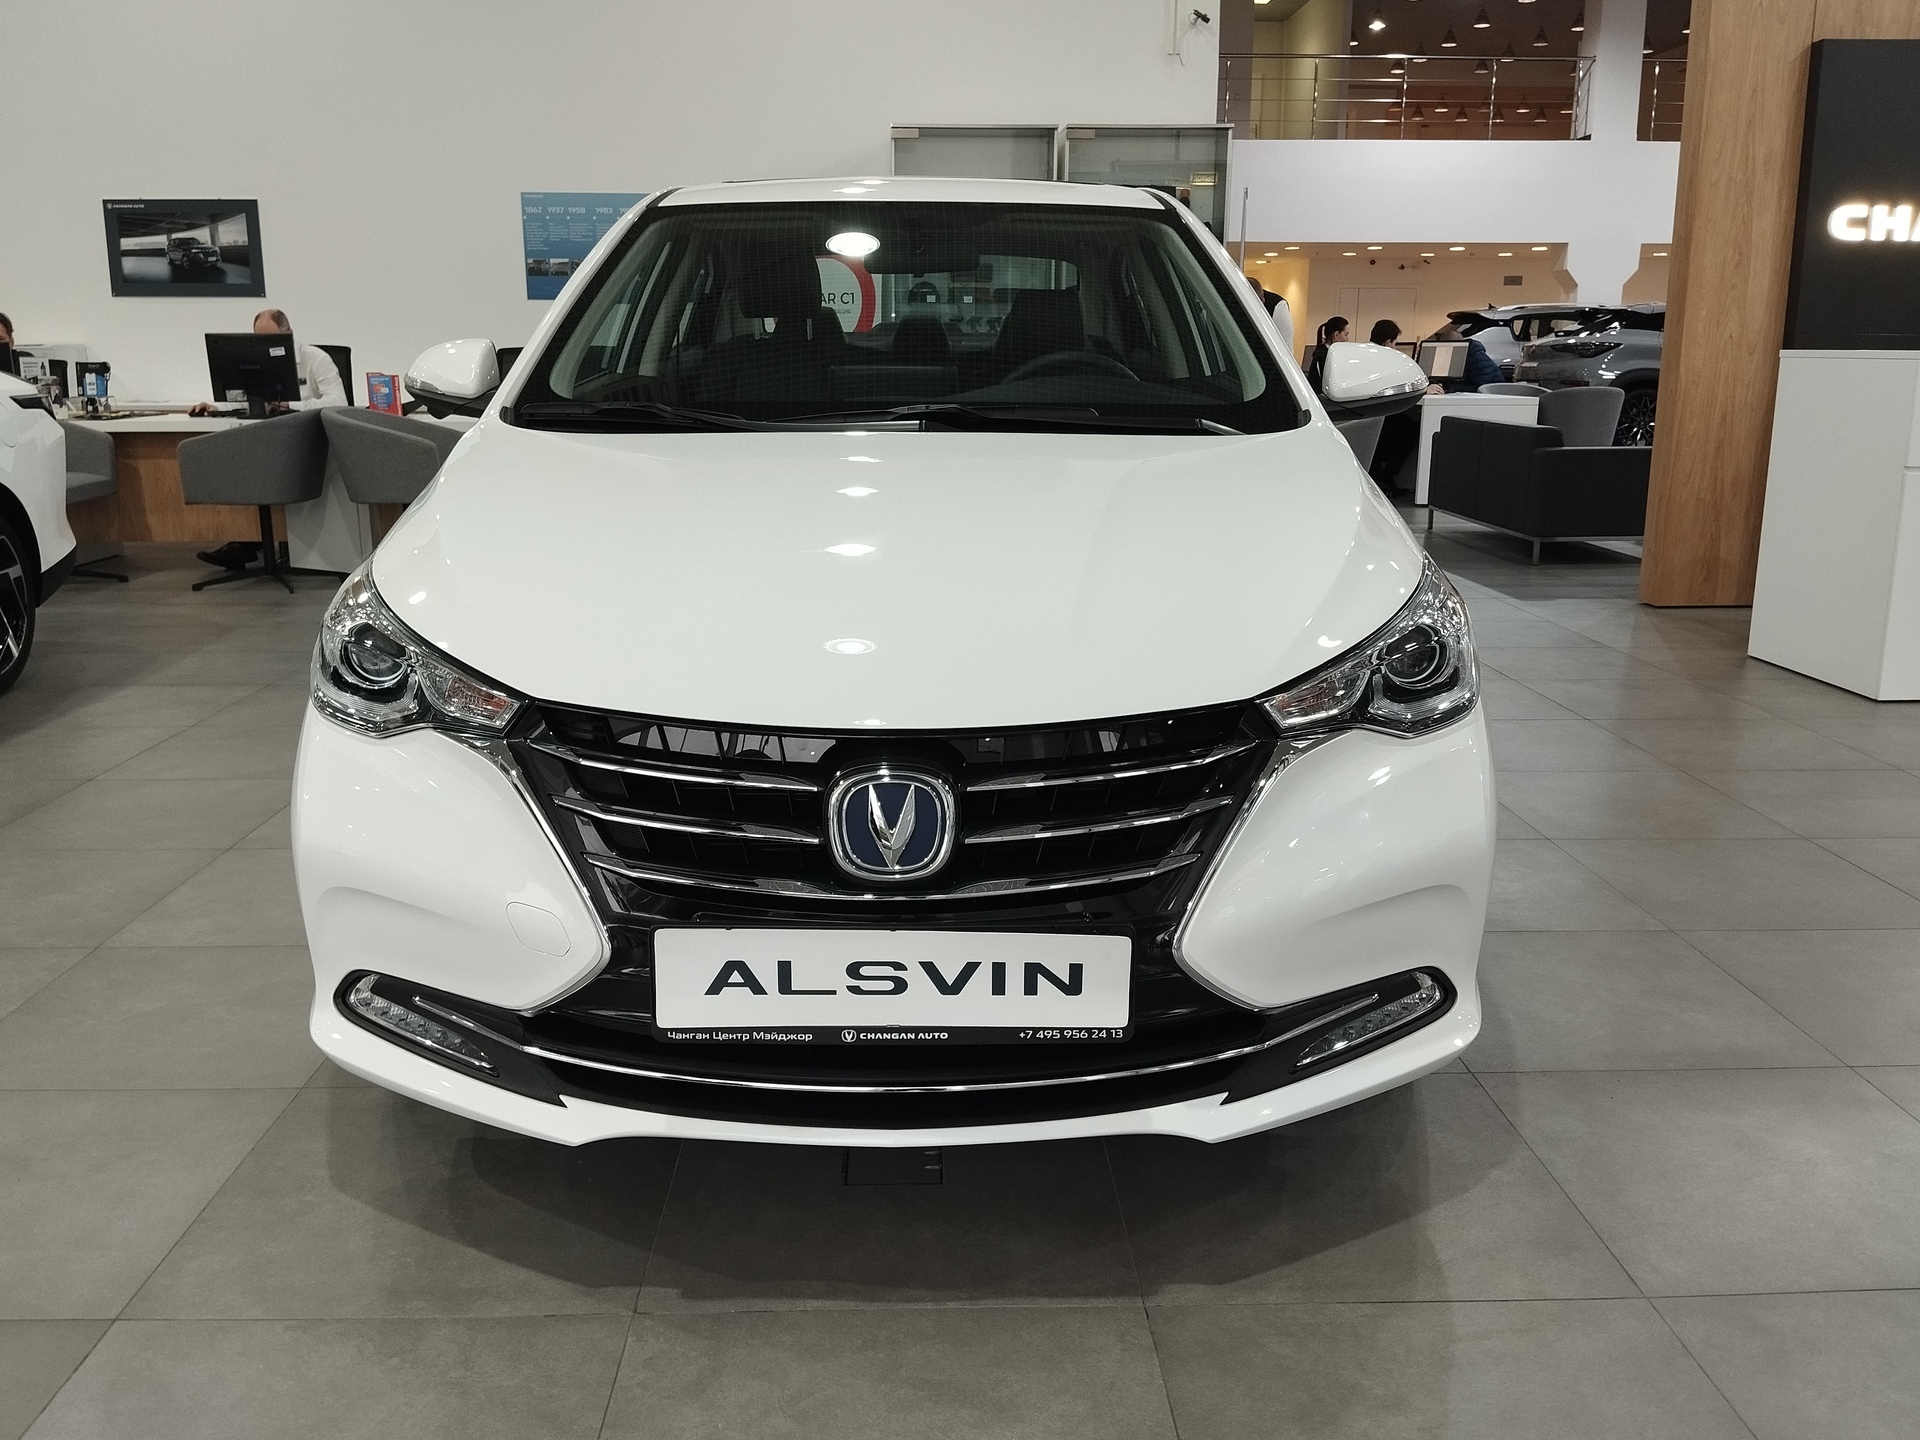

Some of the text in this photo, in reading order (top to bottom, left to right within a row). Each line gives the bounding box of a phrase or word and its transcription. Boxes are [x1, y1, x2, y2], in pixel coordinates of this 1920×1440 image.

[1827, 204, 1920, 241] CH
[840, 292, 855, 304] C1
[704, 960, 1083, 996] ALSVIN
[667, 1031, 813, 1042] Чанган Центр Мэйджор
[859, 1032, 949, 1040] CHANGAN AUTO
[1019, 1029, 1123, 1039] +7 495 956 24 13
